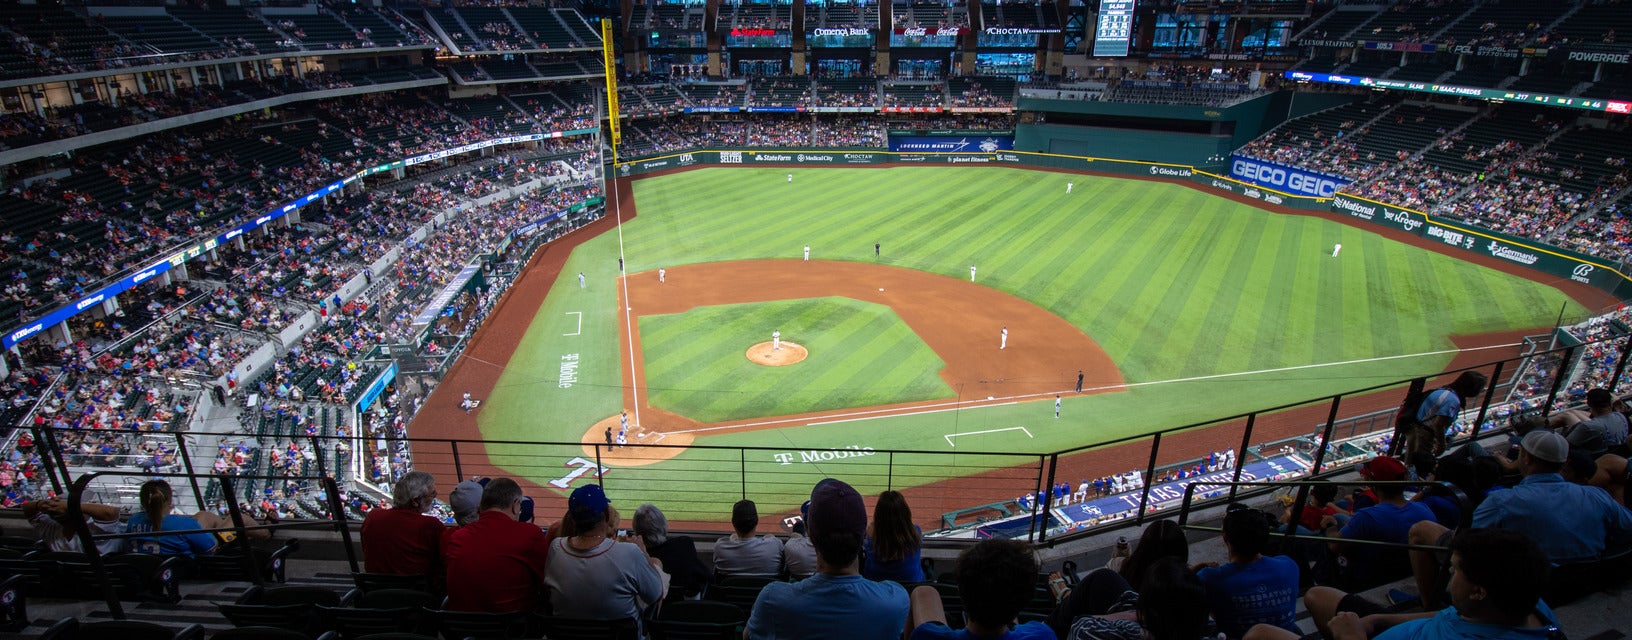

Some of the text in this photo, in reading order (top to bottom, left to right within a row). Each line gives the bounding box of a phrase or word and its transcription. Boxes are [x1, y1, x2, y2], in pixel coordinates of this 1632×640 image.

[850, 28, 869, 36] Bank
[904, 27, 926, 37] Coca-Cola
[936, 27, 959, 37] Coca-Cola
[990, 27, 1029, 35] CHOCTAW
[1325, 40, 1354, 48] STAFFING
[1454, 45, 1474, 54] PGL
[1568, 51, 1630, 64] POWERADE
[1456, 87, 1482, 96] PAREDES
[680, 154, 693, 162] UTA
[1159, 168, 1192, 177] Globe Life
[1232, 160, 1286, 186] GEICO
[1342, 200, 1376, 215] National
[1394, 211, 1424, 231] Kroger
[1443, 230, 1464, 243] BITE
[1501, 246, 1537, 262] Germania
[1571, 274, 1590, 284] SPORTS
[558, 361, 579, 389] Mobile
[799, 445, 876, 463] Mobile
